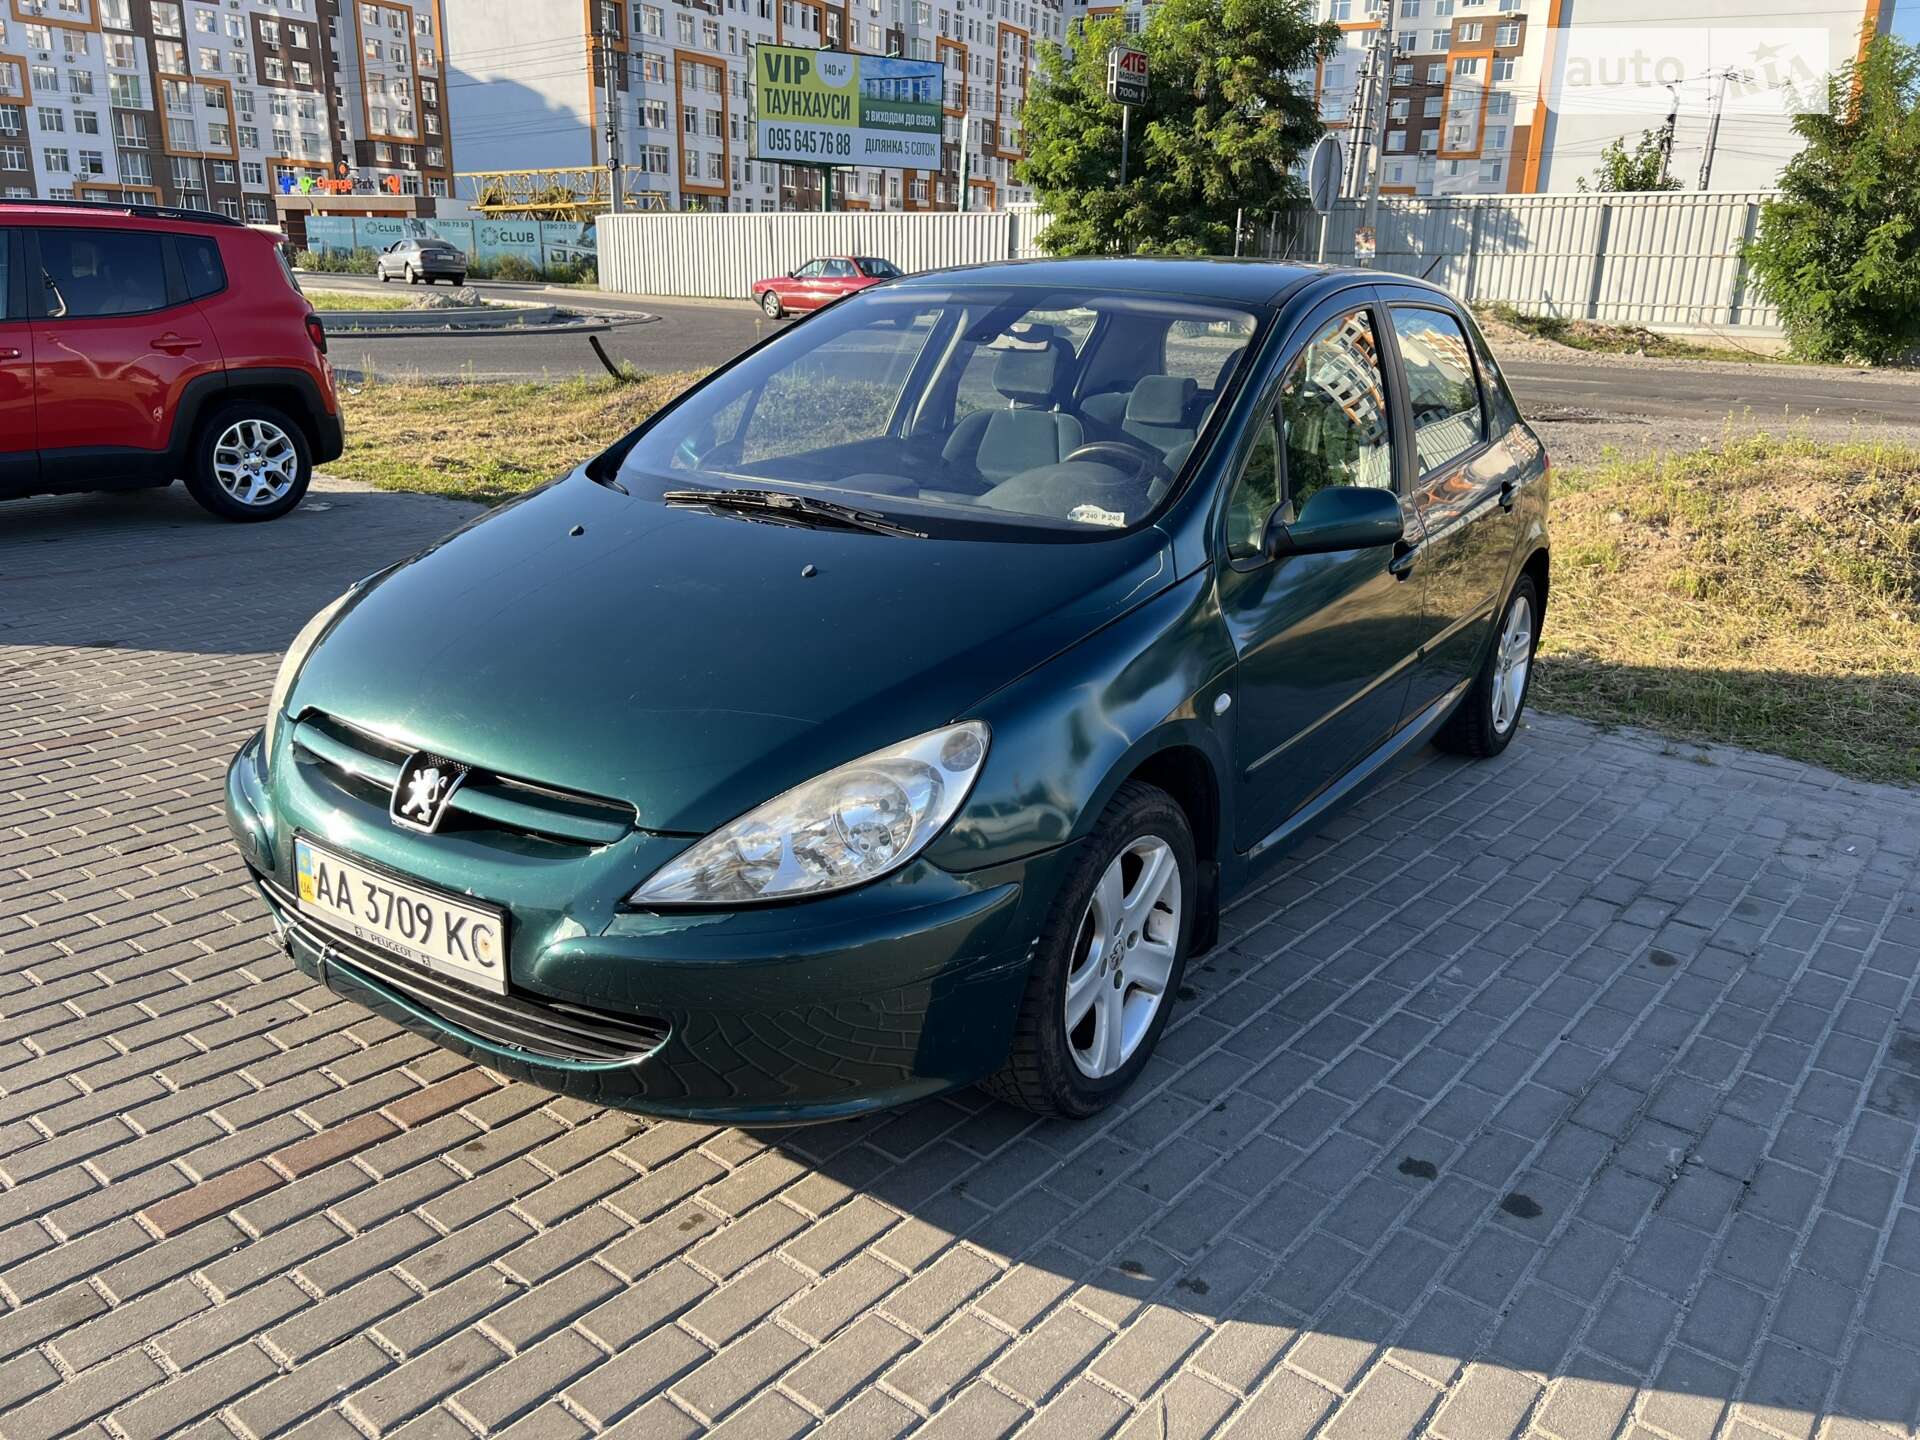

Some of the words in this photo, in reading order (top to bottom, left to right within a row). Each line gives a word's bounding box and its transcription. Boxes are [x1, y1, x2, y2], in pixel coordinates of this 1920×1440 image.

[764, 53, 810, 84] VIP
[823, 63, 837, 76] 140
[764, 88, 850, 121] ТАУНХАУСИ
[870, 110, 904, 125] ВИХОДОМ
[905, 113, 915, 127] ДО
[915, 114, 936, 127] ОЗЕРА
[768, 127, 792, 151] 095
[794, 129, 816, 153] 645
[819, 131, 834, 155] 76
[836, 132, 851, 156] 88
[865, 137, 903, 155] ДІЛЯНКА
[904, 141, 910, 154] 5
[911, 141, 936, 157] СОТОК
[316, 176, 353, 193] Orange
[300, 881, 313, 896] UA
[316, 862, 355, 916] AA
[362, 880, 434, 945] 3709
[444, 911, 496, 969] KC
[370, 933, 412, 958] PEUGEOT
